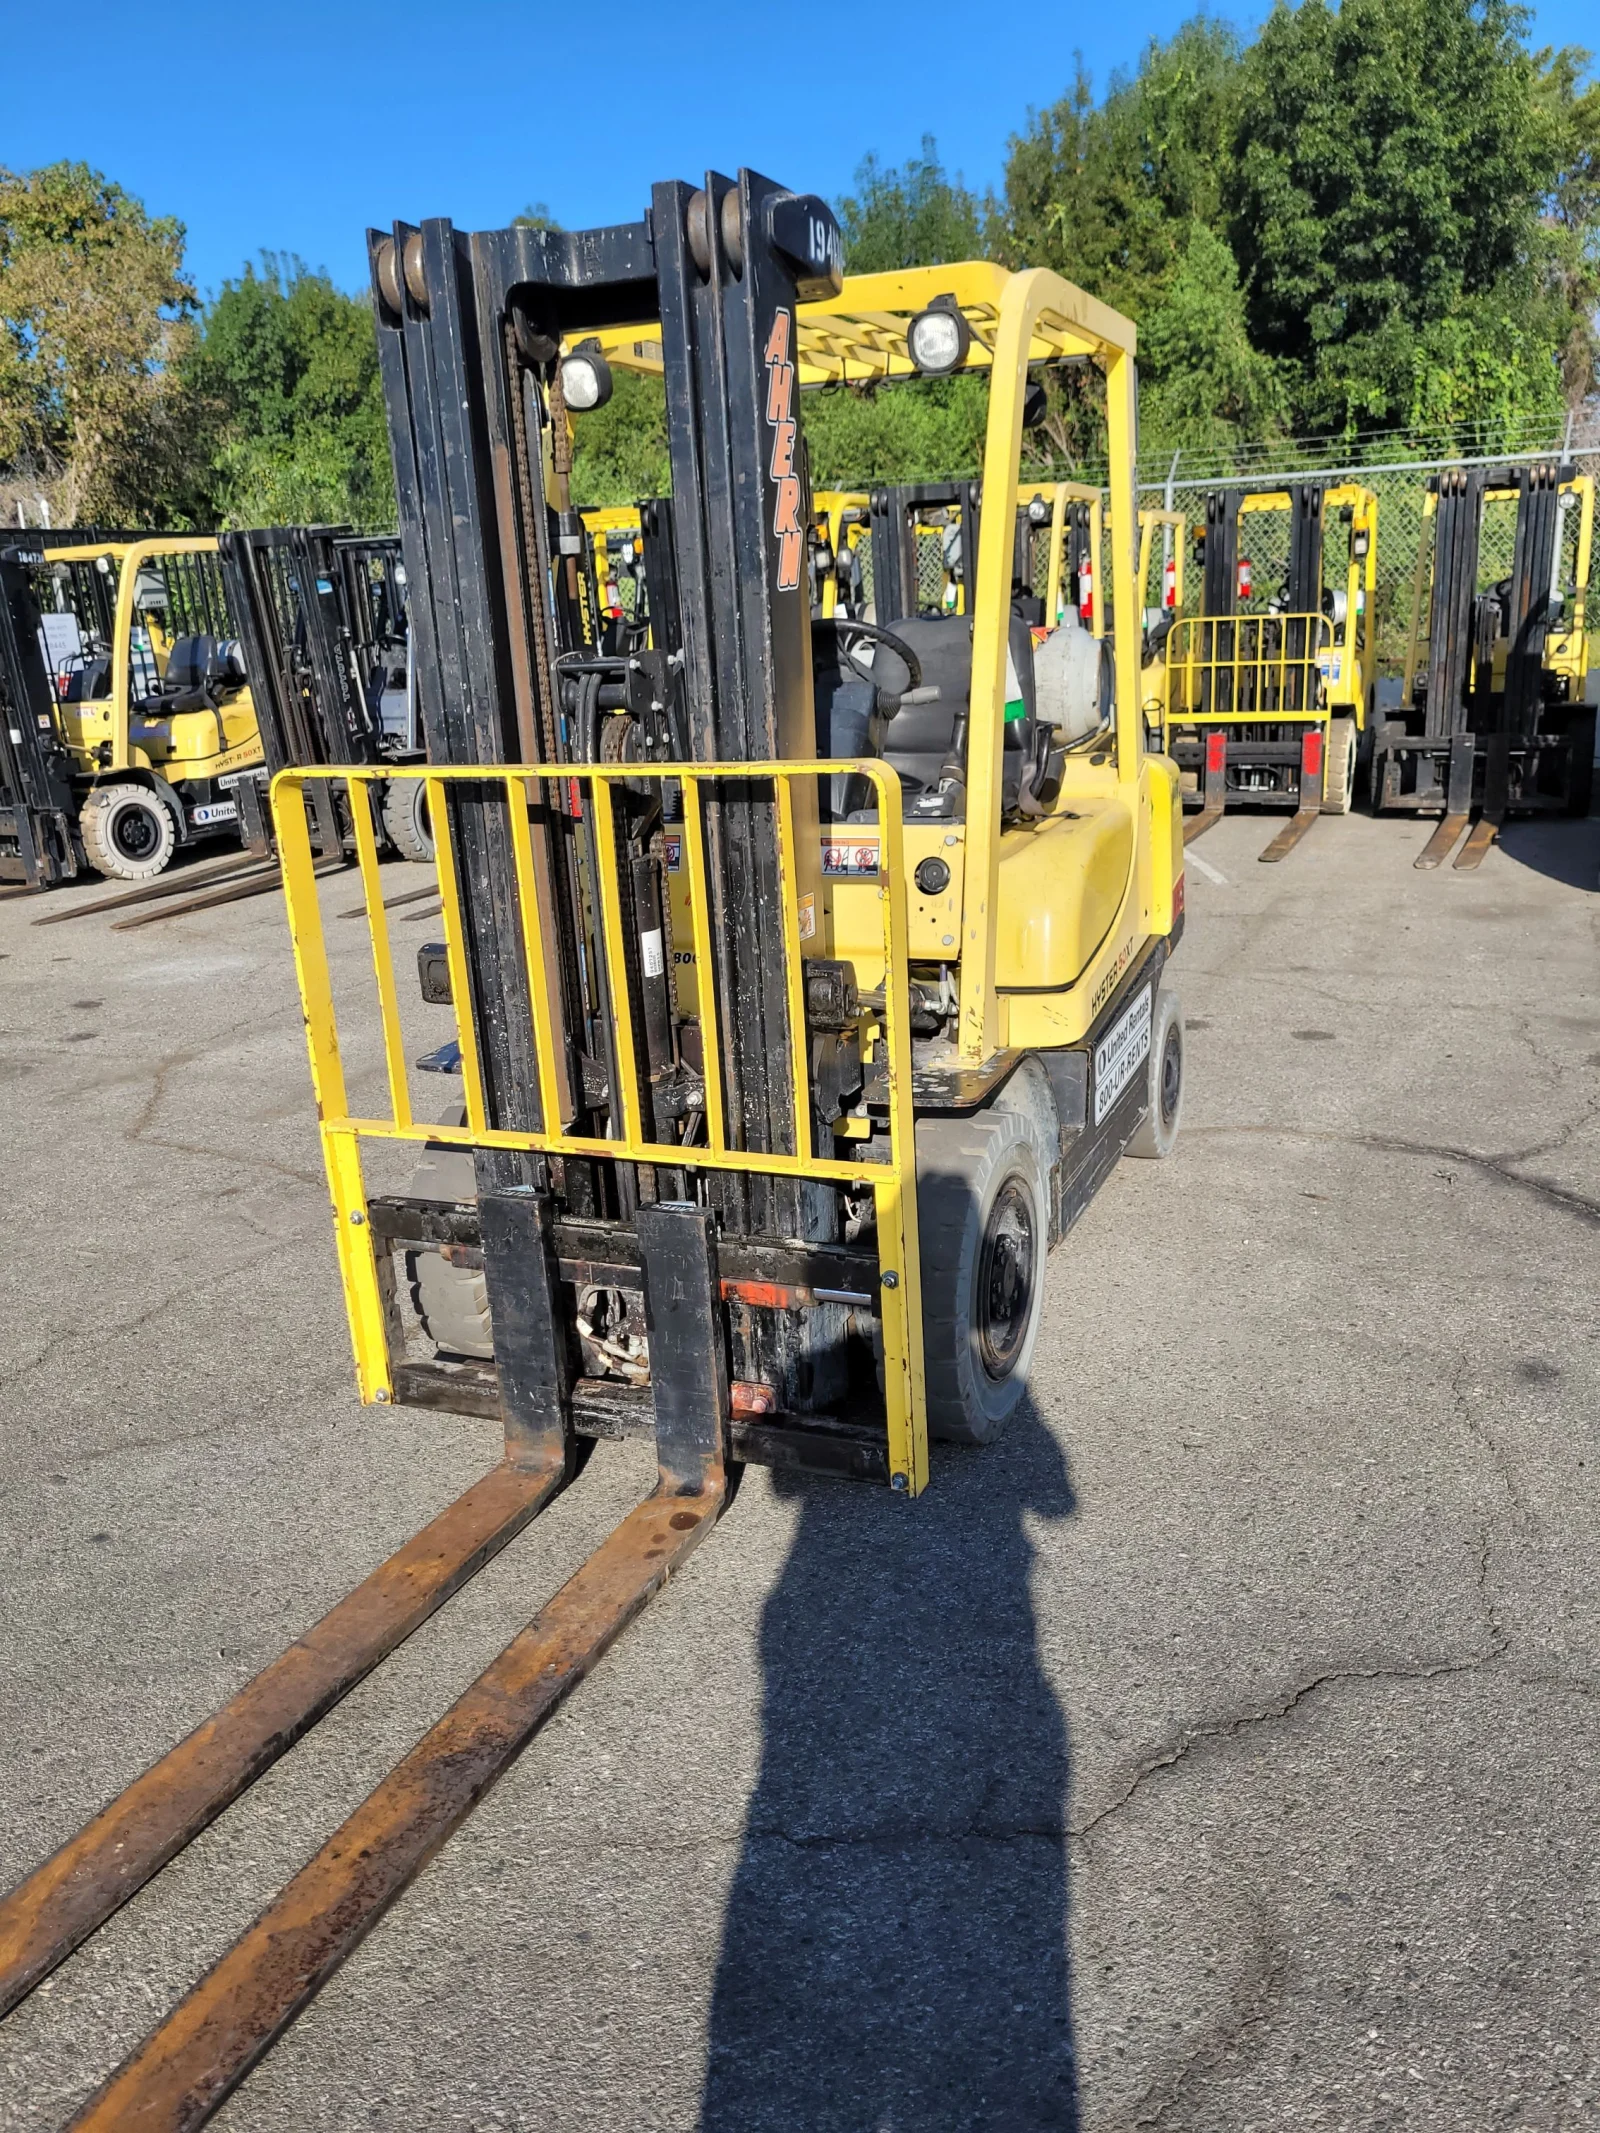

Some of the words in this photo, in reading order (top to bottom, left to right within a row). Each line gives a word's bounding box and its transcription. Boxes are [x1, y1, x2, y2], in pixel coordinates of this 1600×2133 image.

[765, 308, 801, 590] AHERN
[577, 571, 592, 645] HYSTER
[334, 643, 351, 702] TOYOTA
[215, 753, 242, 770] HYSTR
[1091, 960, 1118, 1018] HYSTER
[1118, 936, 1134, 971] 50XT
[1107, 1020, 1128, 1063] United
[1129, 995, 1149, 1035] Rentals
[1099, 1028, 1148, 1114] 800-UR-RENTS
